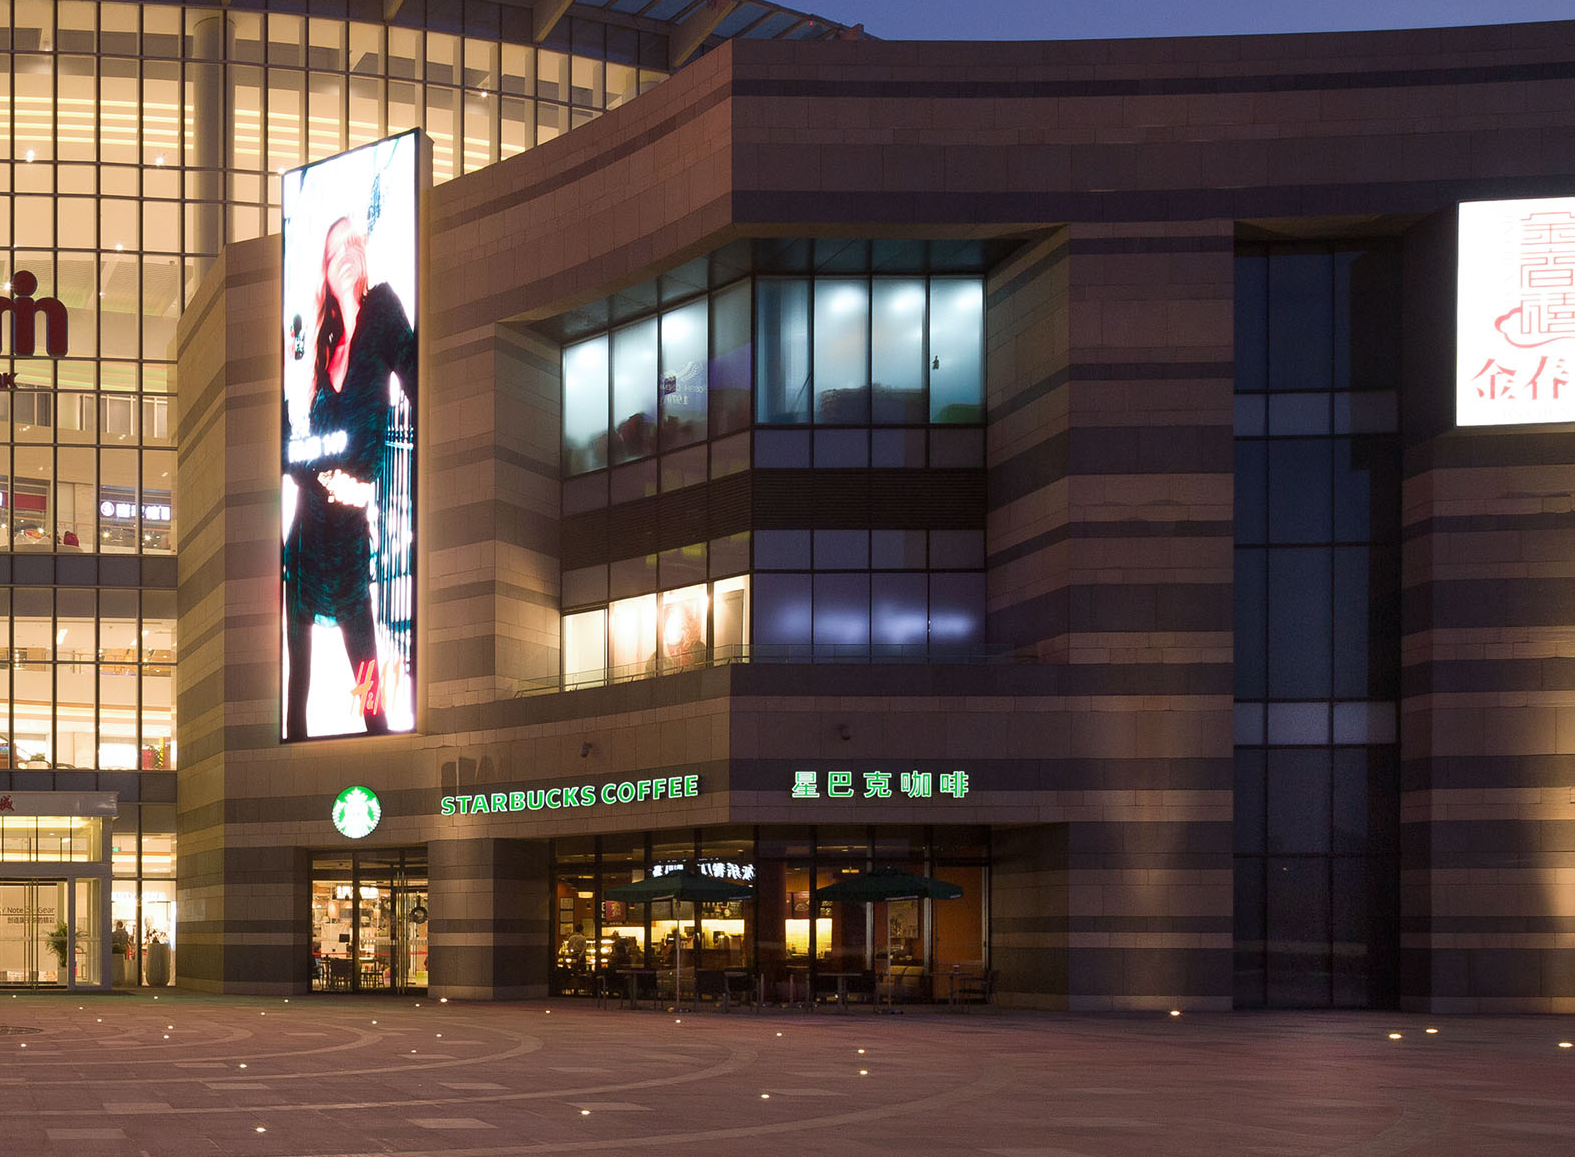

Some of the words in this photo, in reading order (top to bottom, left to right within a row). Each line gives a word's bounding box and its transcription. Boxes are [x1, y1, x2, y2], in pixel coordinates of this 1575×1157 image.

[441, 787, 596, 816] STARBUCKS
[601, 775, 699, 805] COFFEE
[792, 771, 969, 798] 星巴克咖啡
[38, 906, 55, 914] Gear
